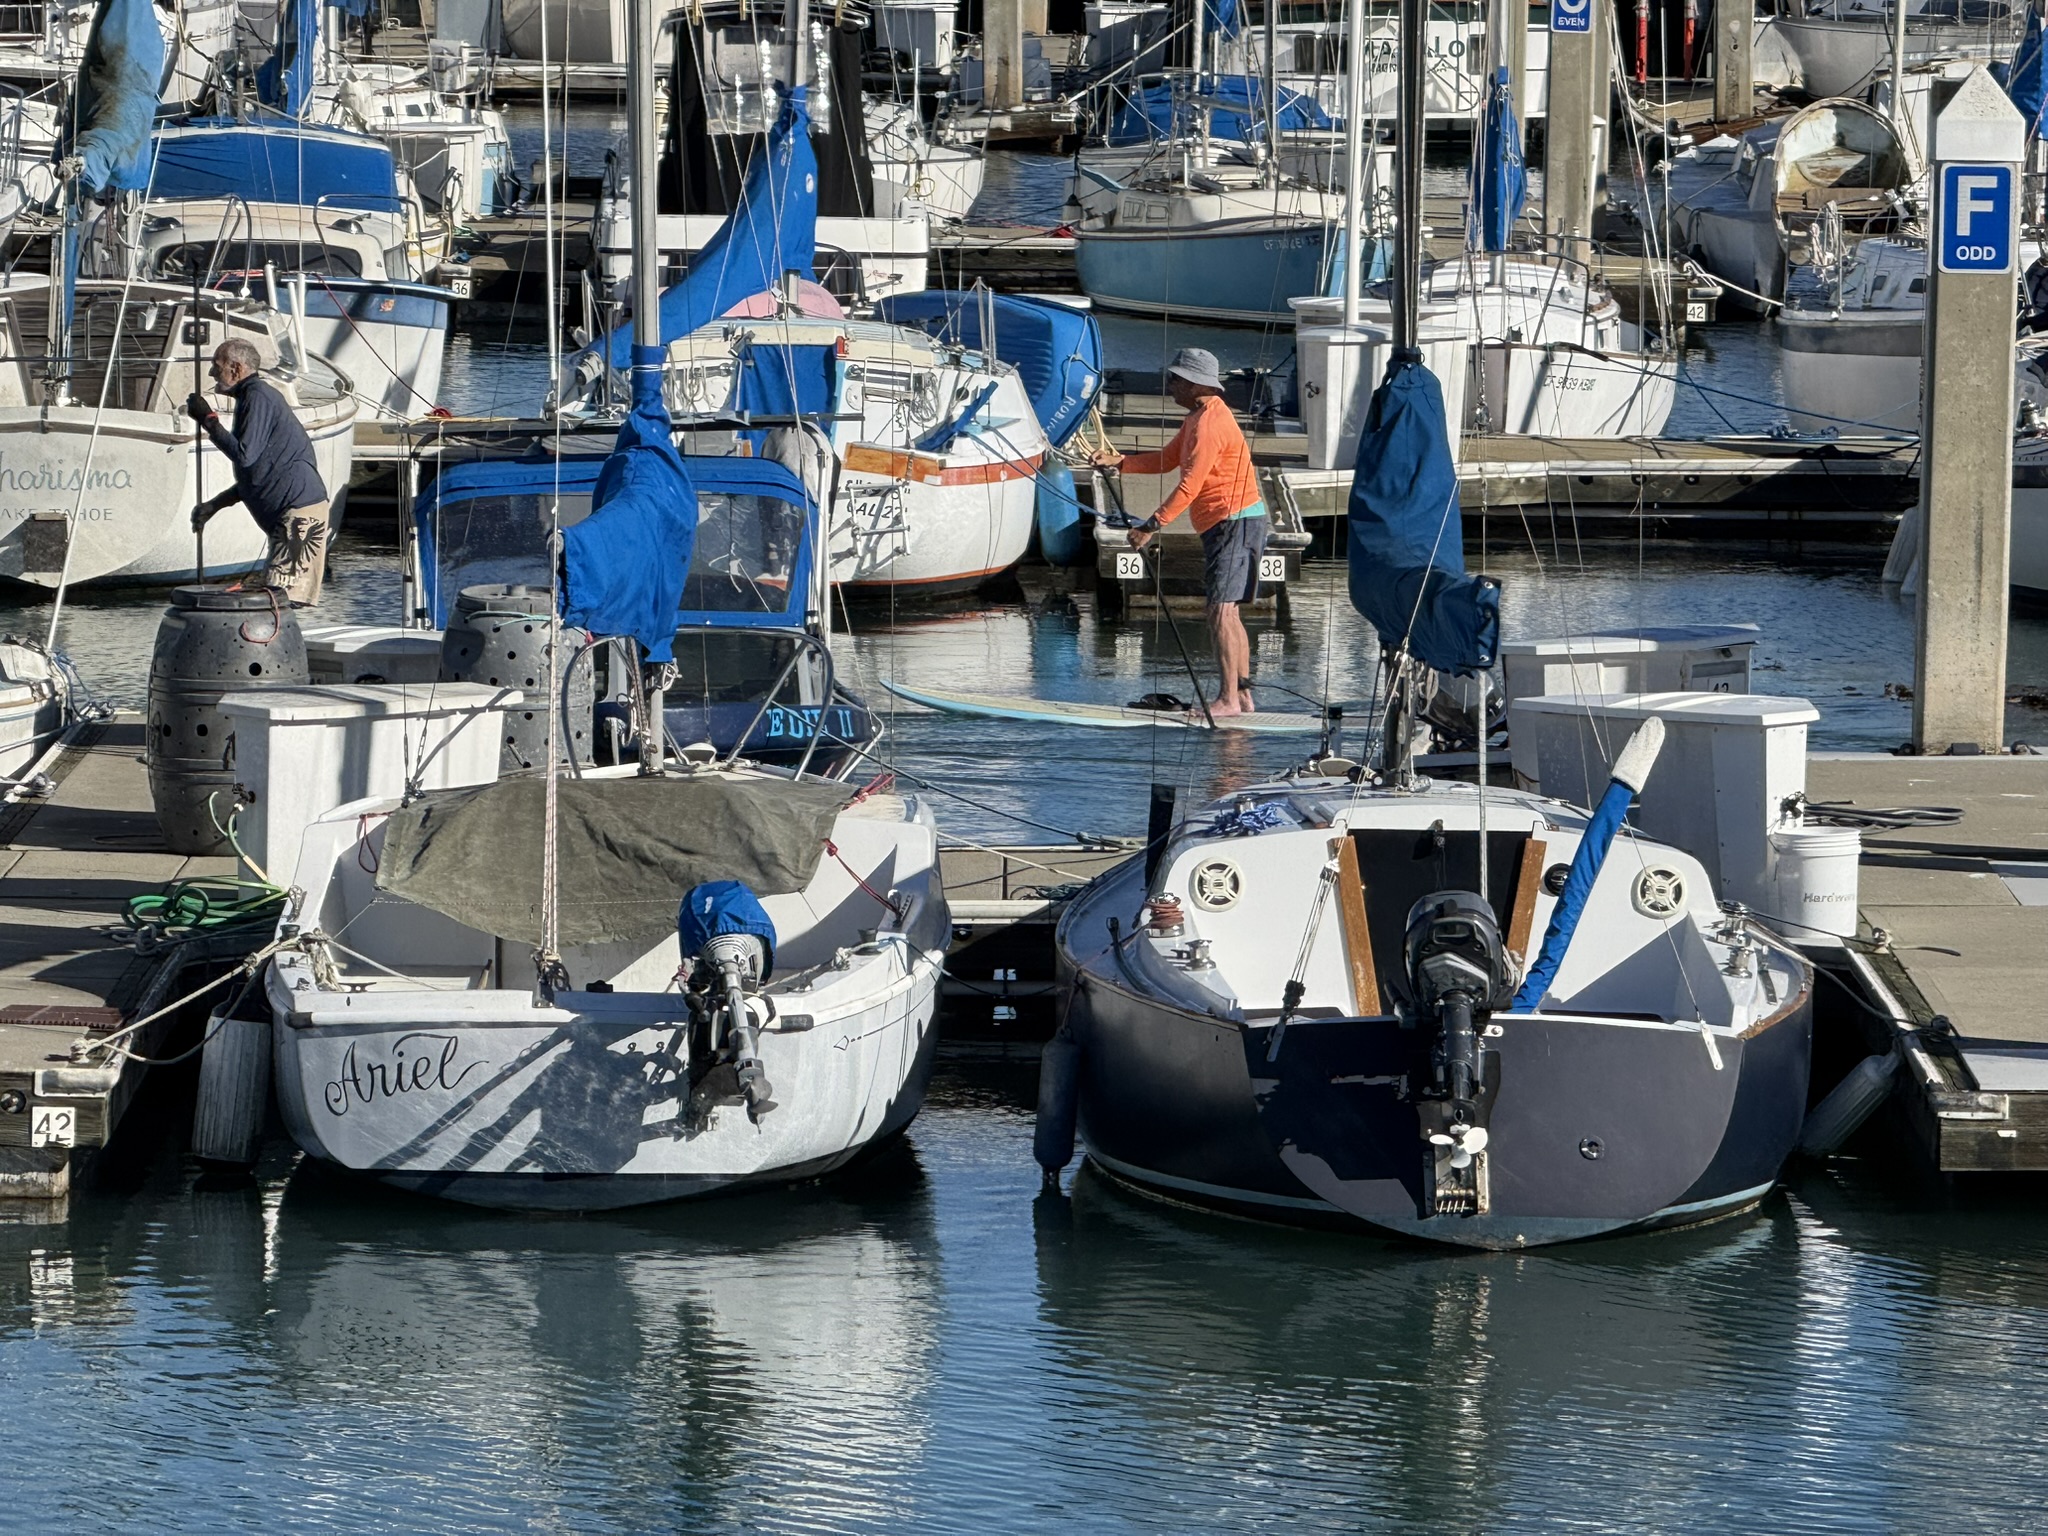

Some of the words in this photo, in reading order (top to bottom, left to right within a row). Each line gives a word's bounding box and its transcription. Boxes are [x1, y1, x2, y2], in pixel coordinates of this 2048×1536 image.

[1557, 16, 1585, 26] EVEN
[1956, 175, 1998, 236] F
[1956, 245, 1996, 261] ODD
[454, 282, 468, 295] 36
[1687, 306, 1704, 319] 42
[1119, 557, 1140, 575] 36
[1261, 559, 1283, 577] 38
[325, 1032, 489, 1116] Ariel
[34, 1112, 71, 1142] 42
